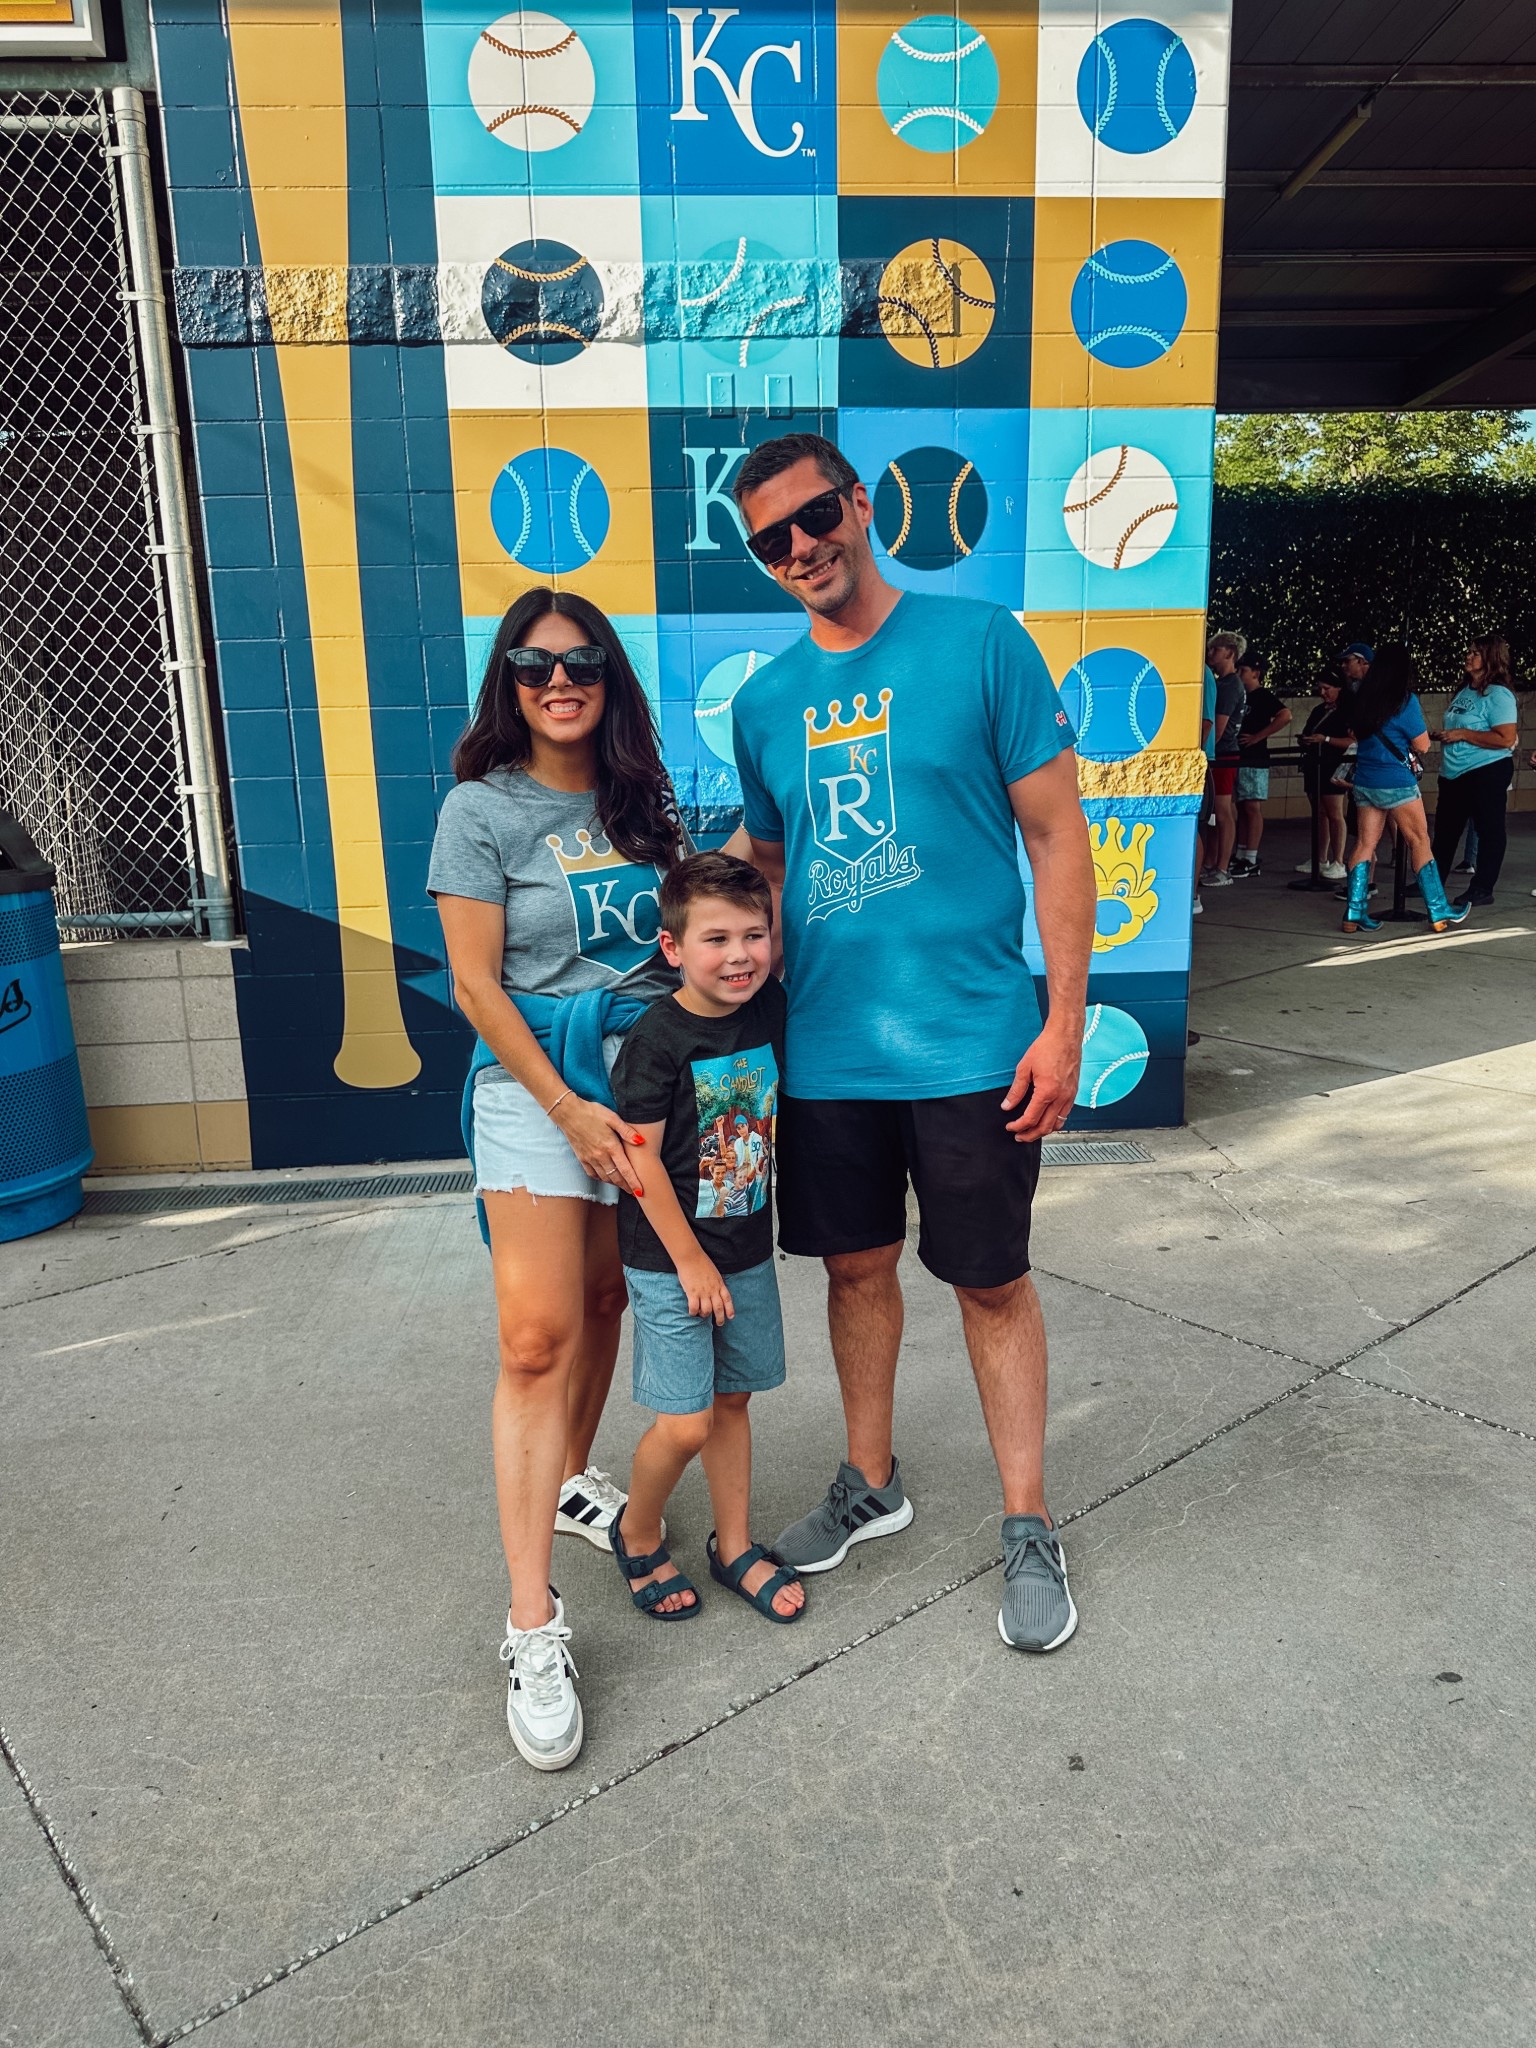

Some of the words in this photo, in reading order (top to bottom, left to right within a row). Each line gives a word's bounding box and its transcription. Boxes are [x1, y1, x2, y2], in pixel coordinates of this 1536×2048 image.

[667, 8, 804, 158] KC
[848, 743, 878, 775] KC
[819, 772, 885, 842] R
[808, 838, 920, 913] Royals
[579, 879, 662, 945] KC
[733, 1057, 748, 1070] THE
